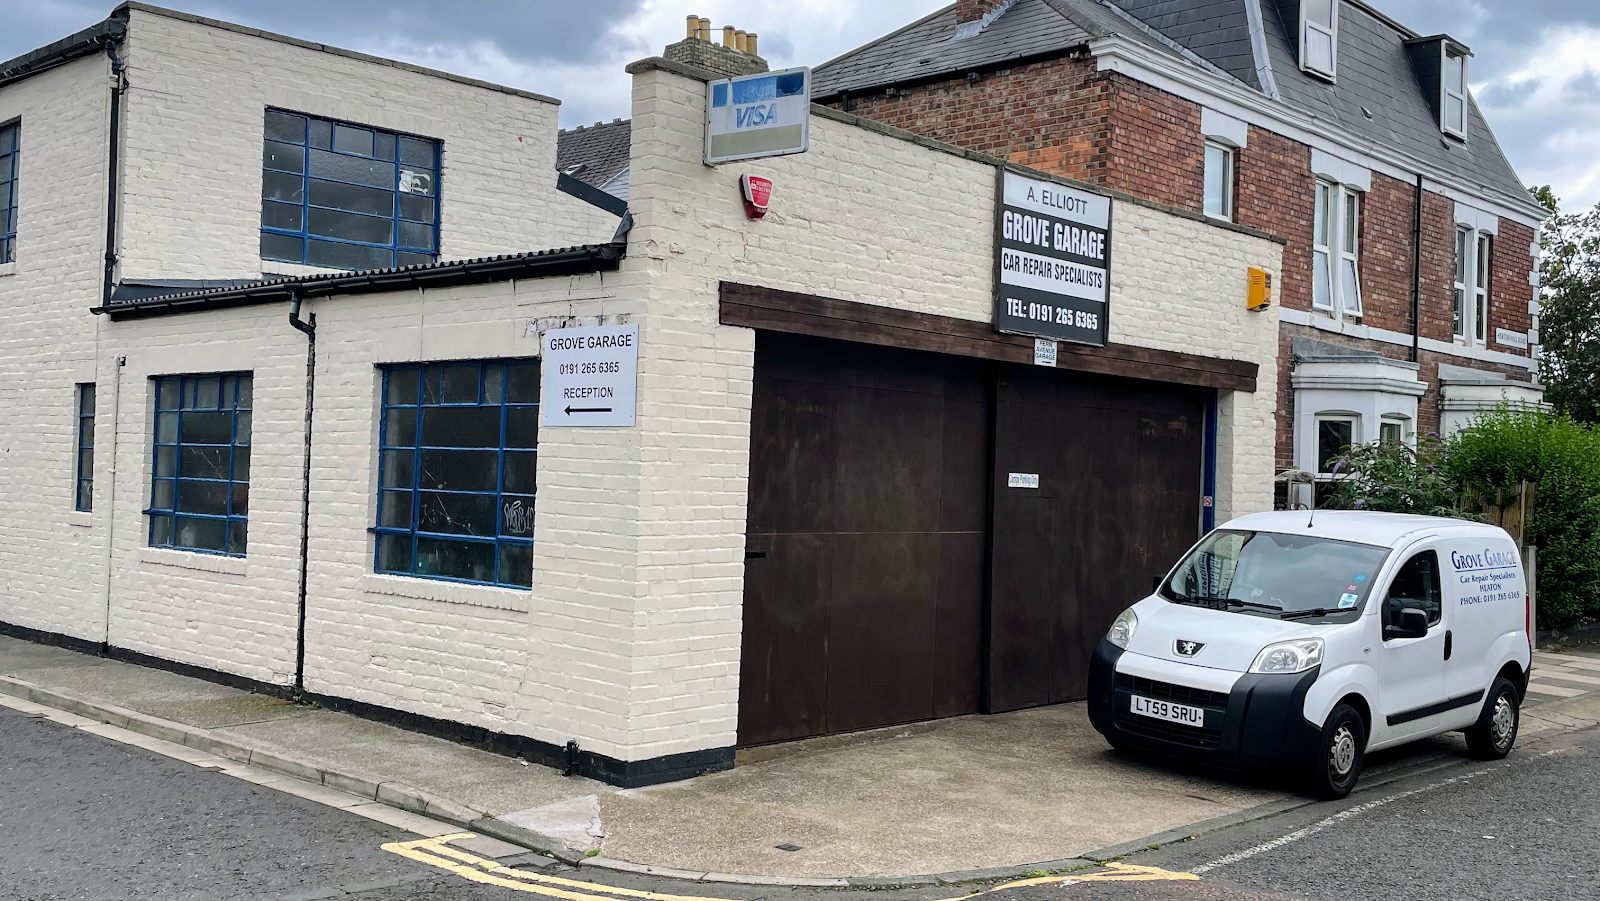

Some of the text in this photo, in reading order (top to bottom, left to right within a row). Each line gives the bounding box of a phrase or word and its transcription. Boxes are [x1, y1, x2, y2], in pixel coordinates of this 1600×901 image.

[736, 103, 778, 128] VISA
[1027, 186, 1088, 215] A. ELLIOTT
[1003, 210, 1105, 260] GROVE GARAGE
[1003, 252, 1103, 289] CAR REPAIR SPECIALISTS
[1007, 298, 1098, 330] TEL: 0191 265 6365
[550, 334, 632, 350] GROVE GARAGE
[1039, 340, 1053, 348] FERN
[1035, 346, 1056, 354] AVENUE
[1035, 352, 1056, 360] GARAGE
[560, 361, 620, 374] 0191 265 6365
[563, 387, 613, 398] RECEPTION
[1471, 574, 1488, 583] Repair
[1490, 571, 1515, 581] Specialists
[1479, 583, 1501, 592] HEATON
[1460, 591, 1520, 605] PHONE: 0191 265 6365
[1136, 698, 1197, 722] LT59 SRU
